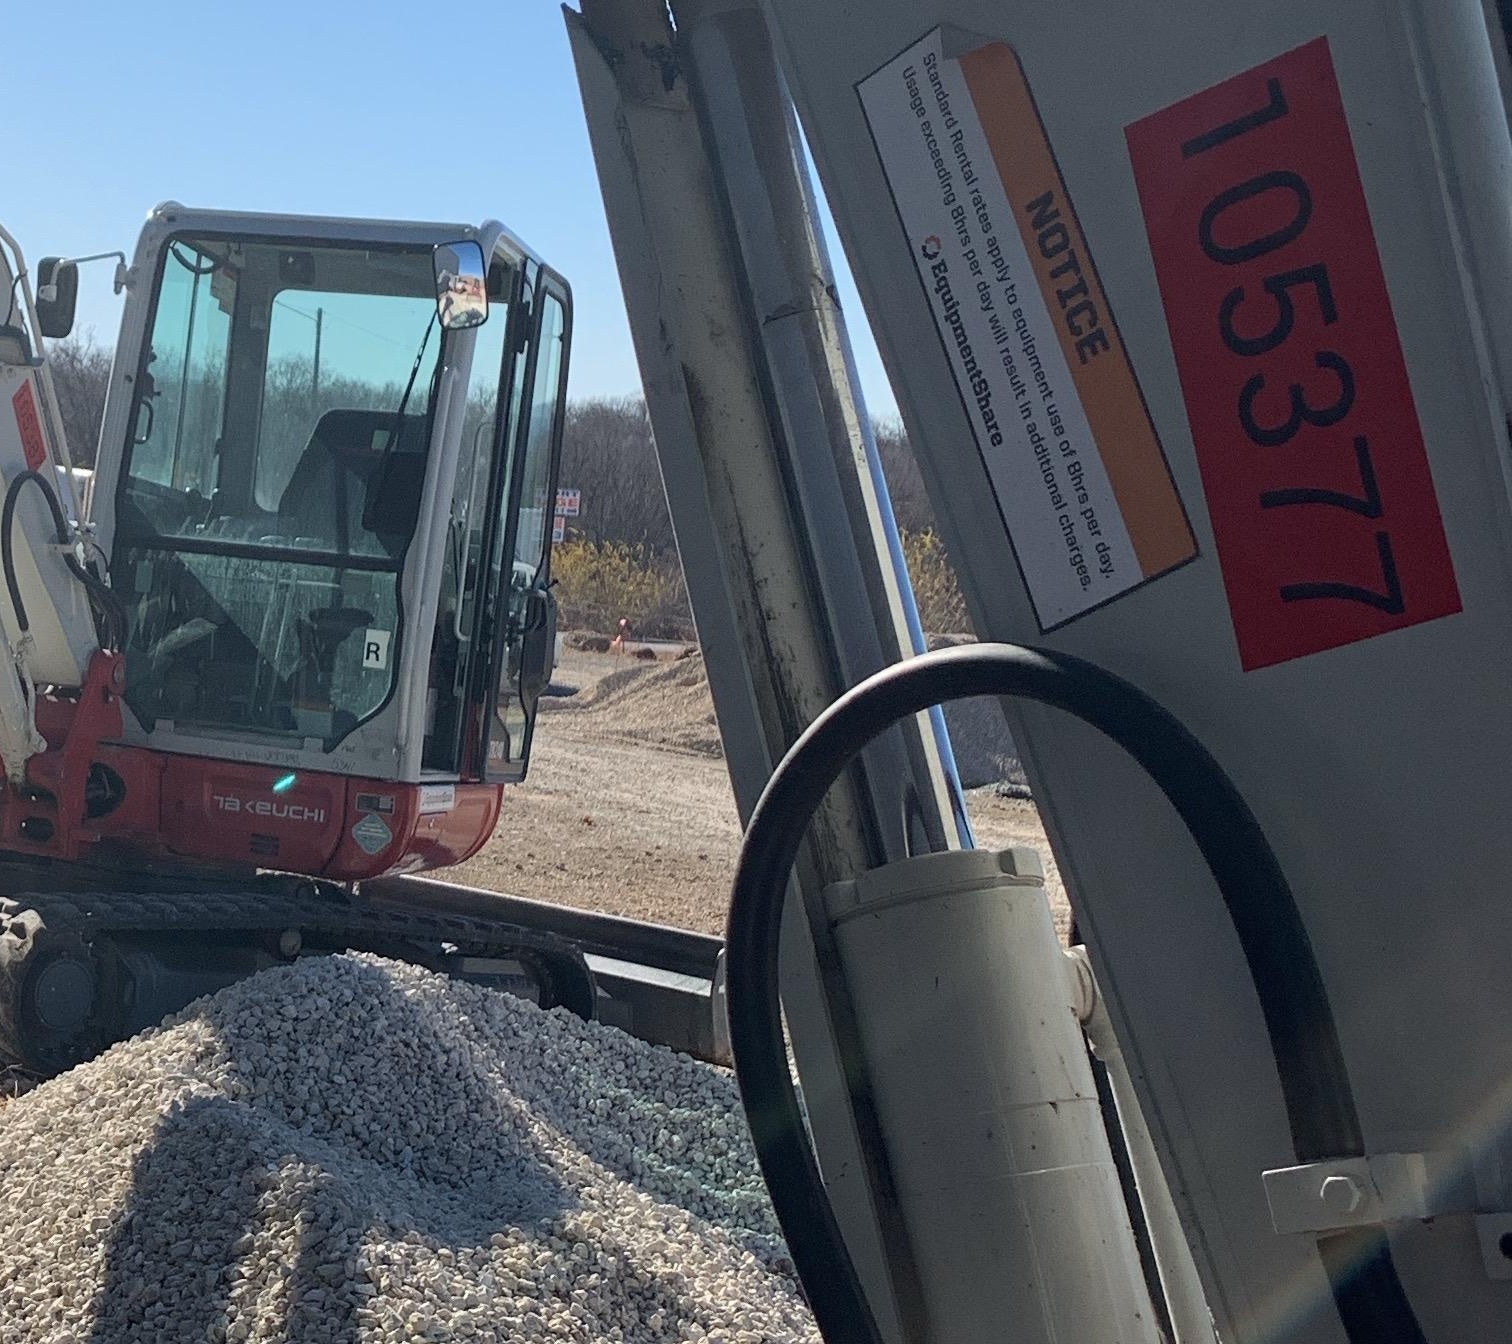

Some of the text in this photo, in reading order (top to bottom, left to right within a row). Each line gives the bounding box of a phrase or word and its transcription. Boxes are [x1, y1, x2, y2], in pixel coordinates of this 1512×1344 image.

[902, 65, 1091, 591] Usage exceeding 8hrs per day will result in additional charges.
[923, 52, 1114, 578] Standard Rental rates apply to equipment use of 8hrs per day.
[930, 258, 1002, 447] EquipmentShare
[1025, 190, 1110, 365] NOTICE
[1181, 77, 1406, 616] 105377
[366, 641, 380, 661] R
